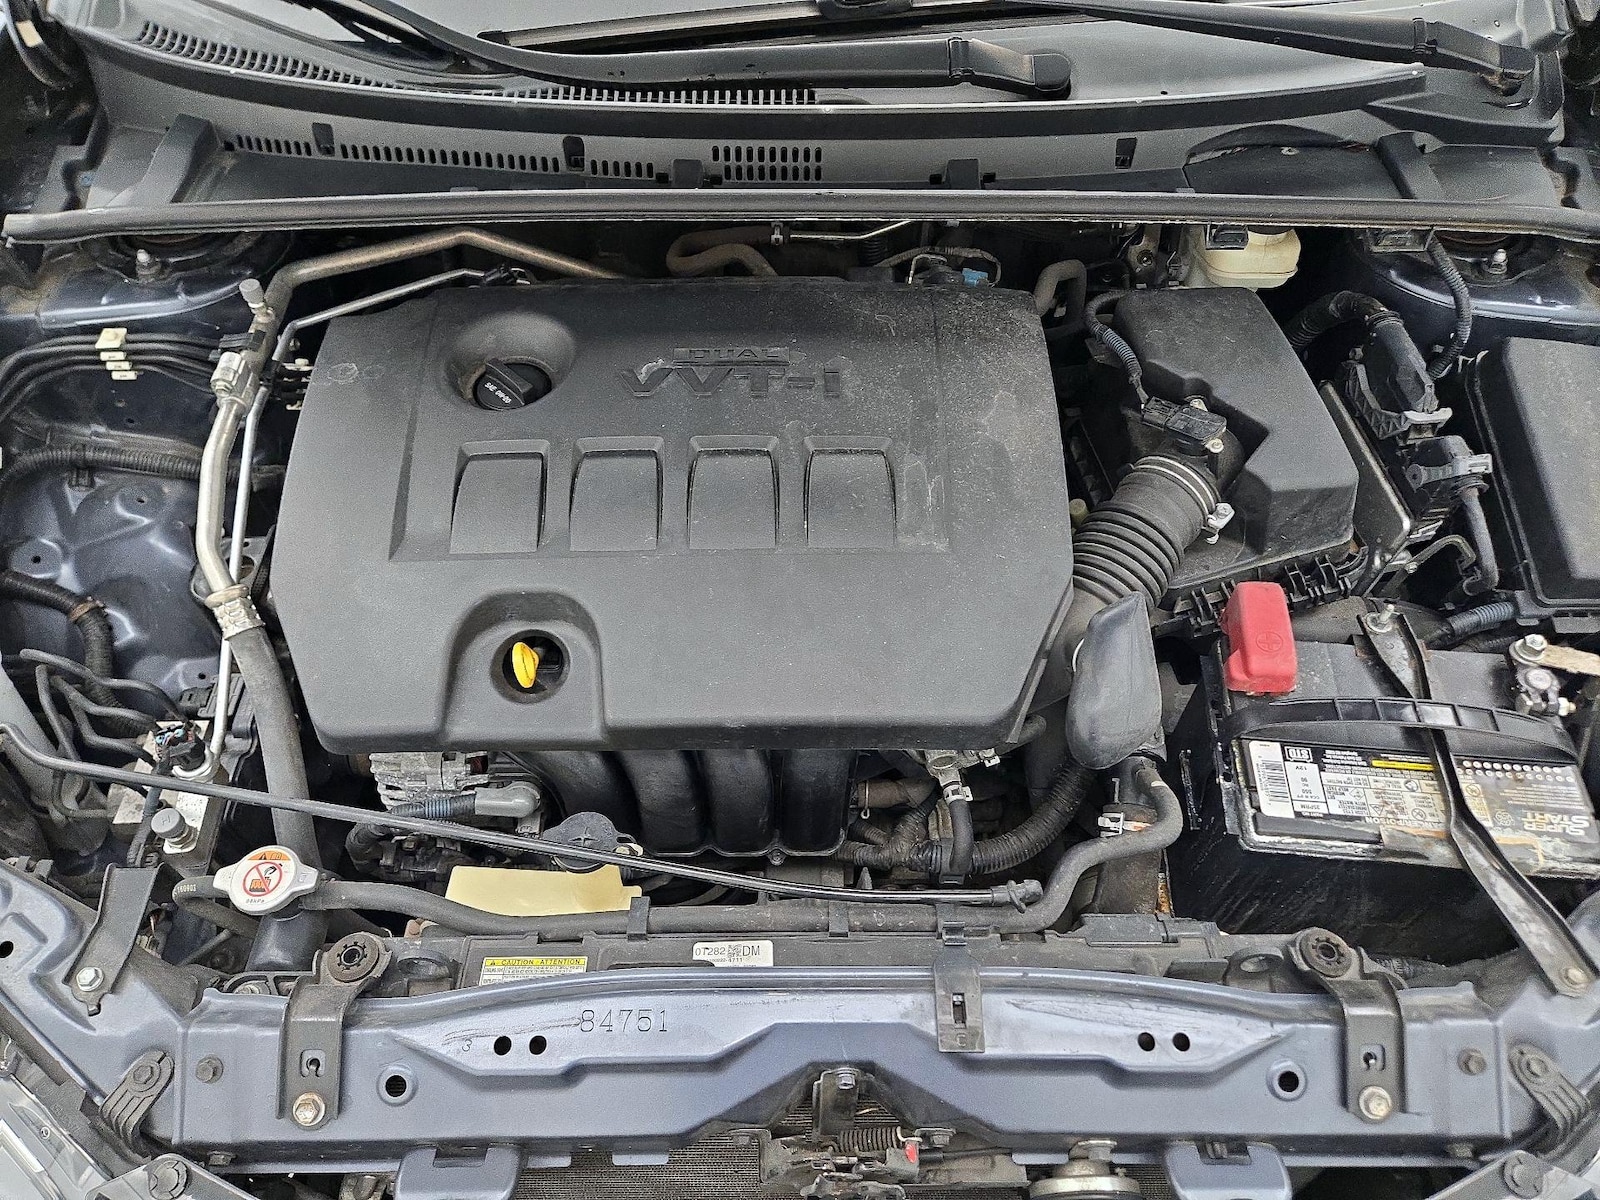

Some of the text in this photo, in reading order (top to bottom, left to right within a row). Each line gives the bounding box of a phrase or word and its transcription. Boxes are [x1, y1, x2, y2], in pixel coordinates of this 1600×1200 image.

[688, 348, 780, 359] DUAL
[484, 382, 498, 392] SAE
[1287, 748, 1311, 760] STD
[1521, 811, 1590, 828] START
[1523, 820, 1586, 836] SUPER
[742, 945, 761, 957] DM
[580, 1009, 668, 1032] 84751
[461, 1038, 473, 1052] 3
